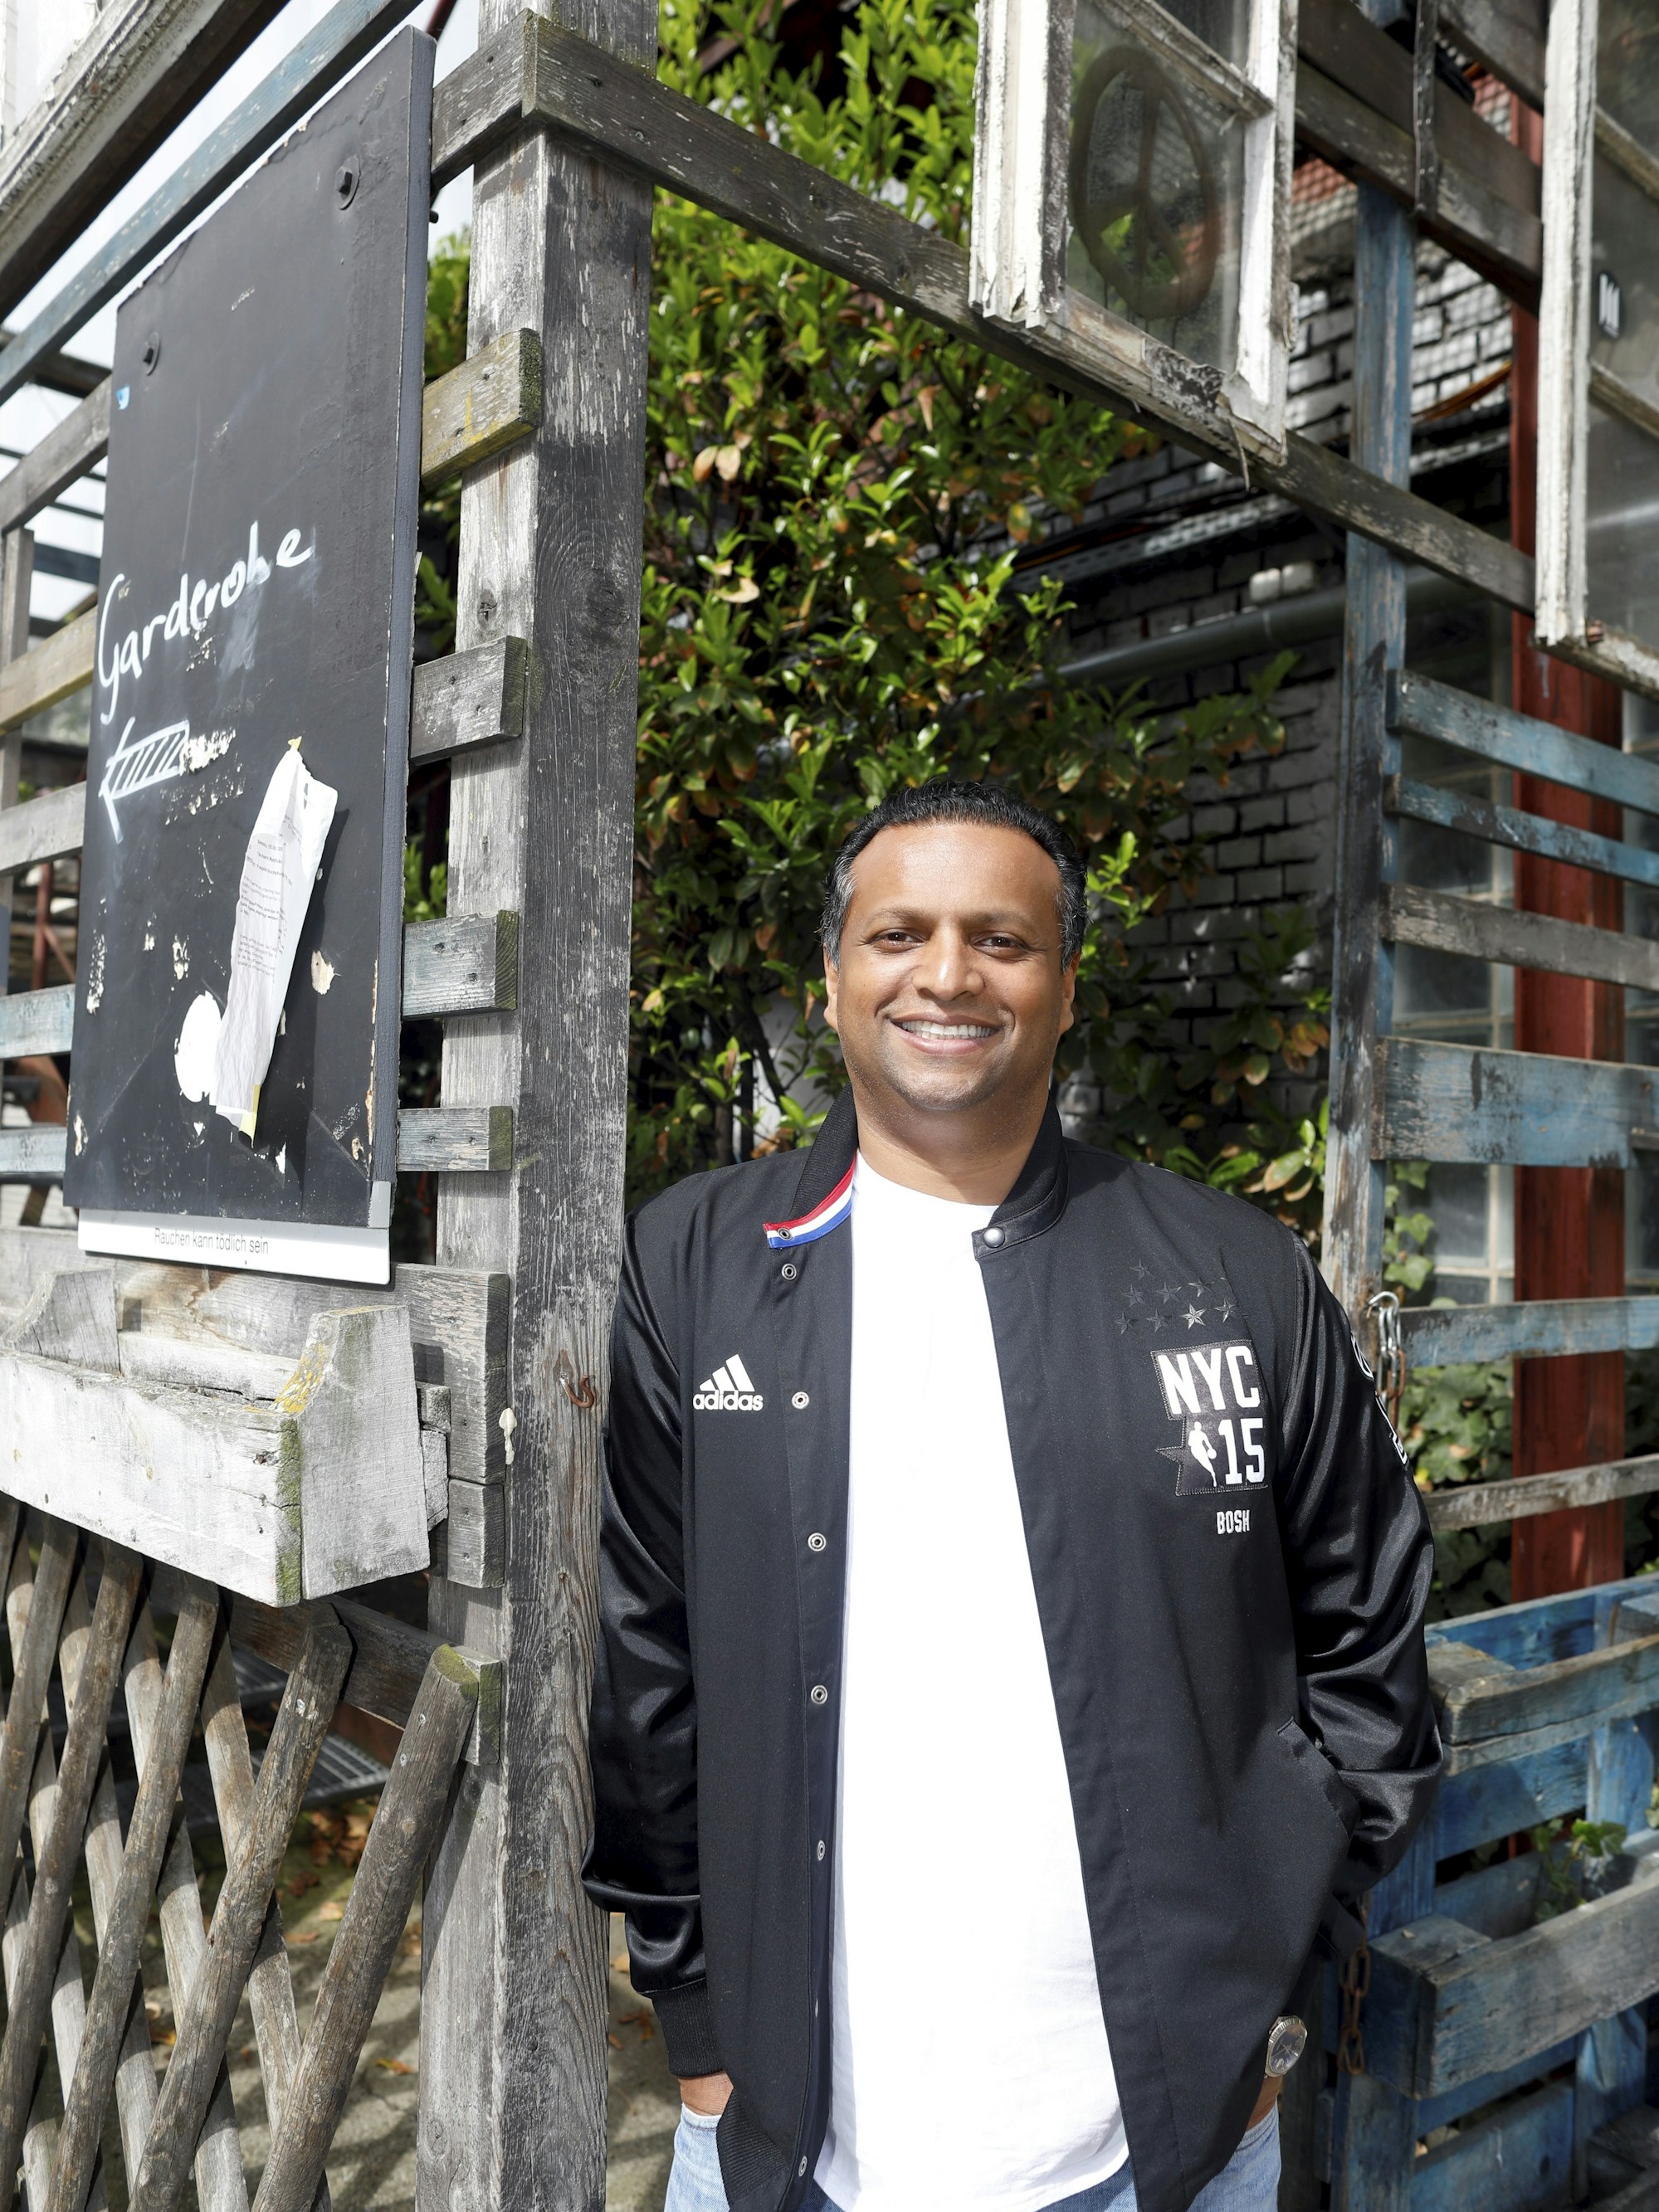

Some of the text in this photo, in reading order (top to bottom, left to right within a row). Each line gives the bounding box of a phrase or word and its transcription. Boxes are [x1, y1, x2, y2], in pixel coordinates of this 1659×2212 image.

[98, 520, 316, 724] Garderobe
[155, 1228, 269, 1254] Rauchen kann tödlich sein
[693, 1390, 764, 1411] adidas
[1158, 1346, 1261, 1414] NYC
[1218, 1418, 1265, 1484] 15
[1217, 1510, 1251, 1534] BOSH
